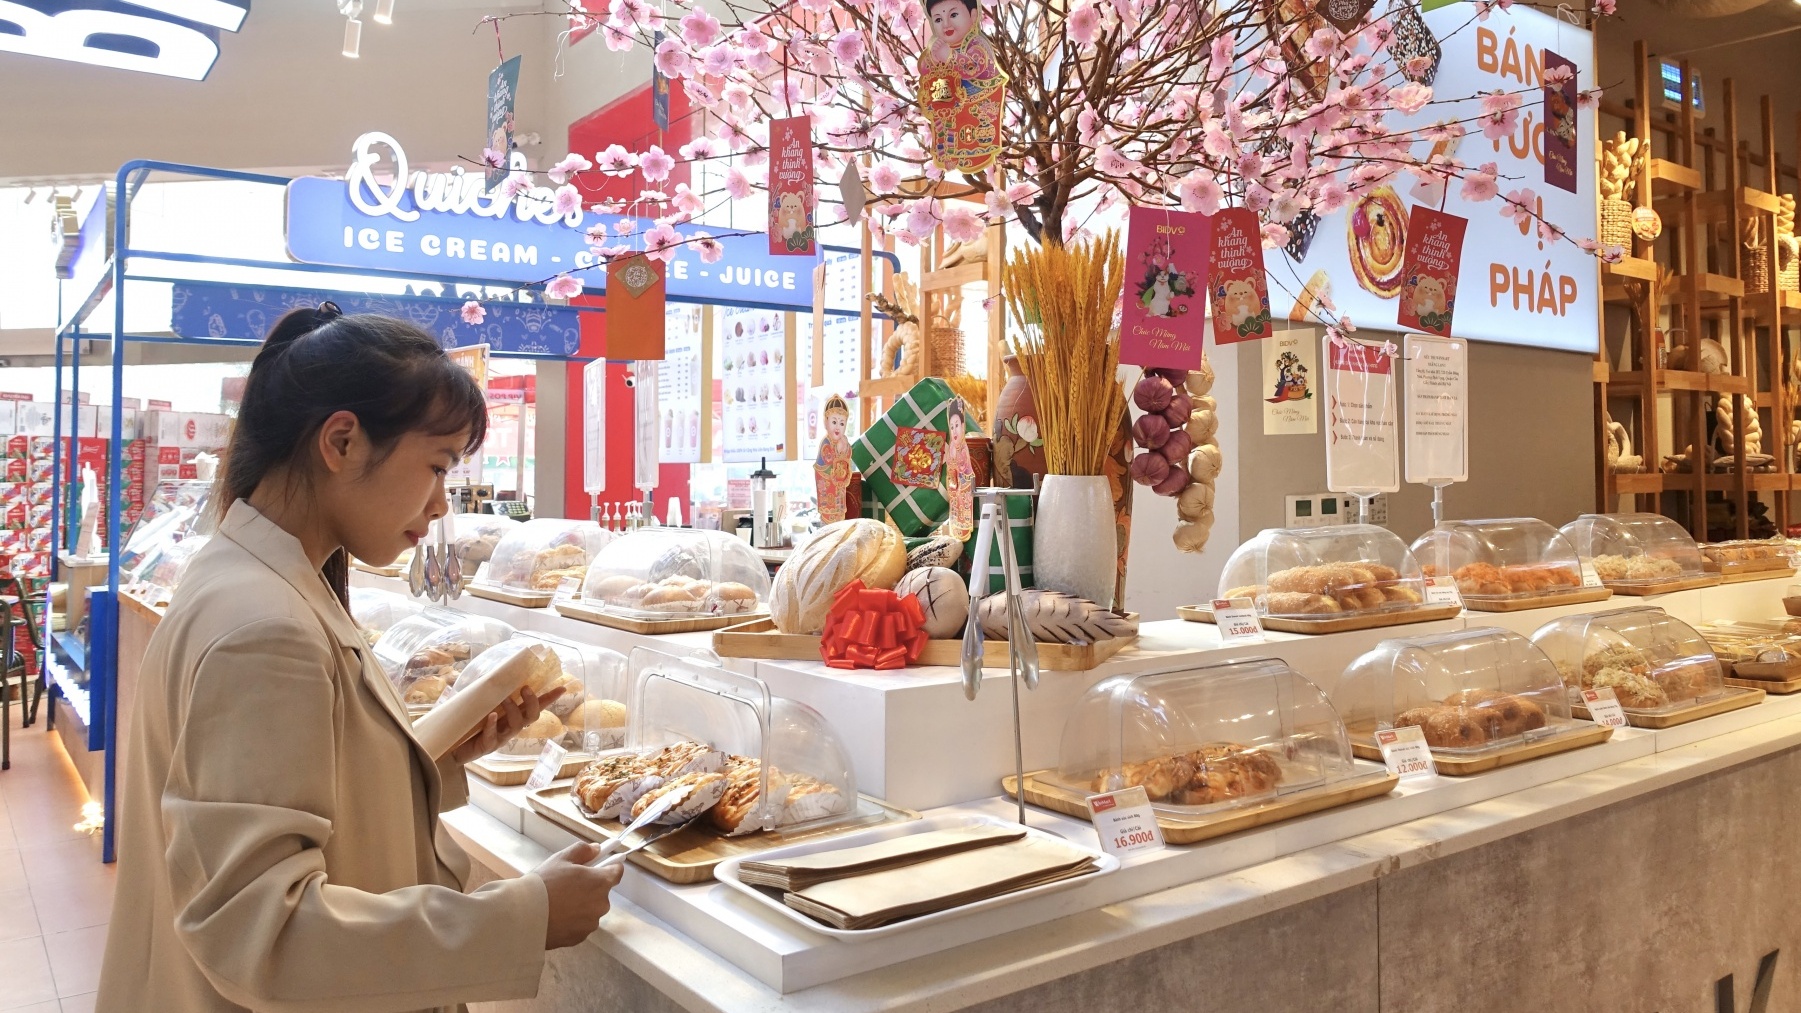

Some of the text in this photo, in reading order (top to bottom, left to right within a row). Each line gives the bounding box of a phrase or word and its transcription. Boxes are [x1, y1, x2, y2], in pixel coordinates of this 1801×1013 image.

[1476, 25, 1545, 91] BÁN
[782, 147, 803, 159] khang
[1226, 227, 1243, 239] An
[1433, 230, 1448, 242] An
[1217, 235, 1248, 251] khang
[1422, 235, 1451, 252] khang
[343, 226, 405, 253] ICE
[420, 235, 538, 266] CREAM
[719, 265, 796, 290] JUICE
[1489, 259, 1578, 317] PHÁP
[1114, 830, 1154, 849] 16.900đ
